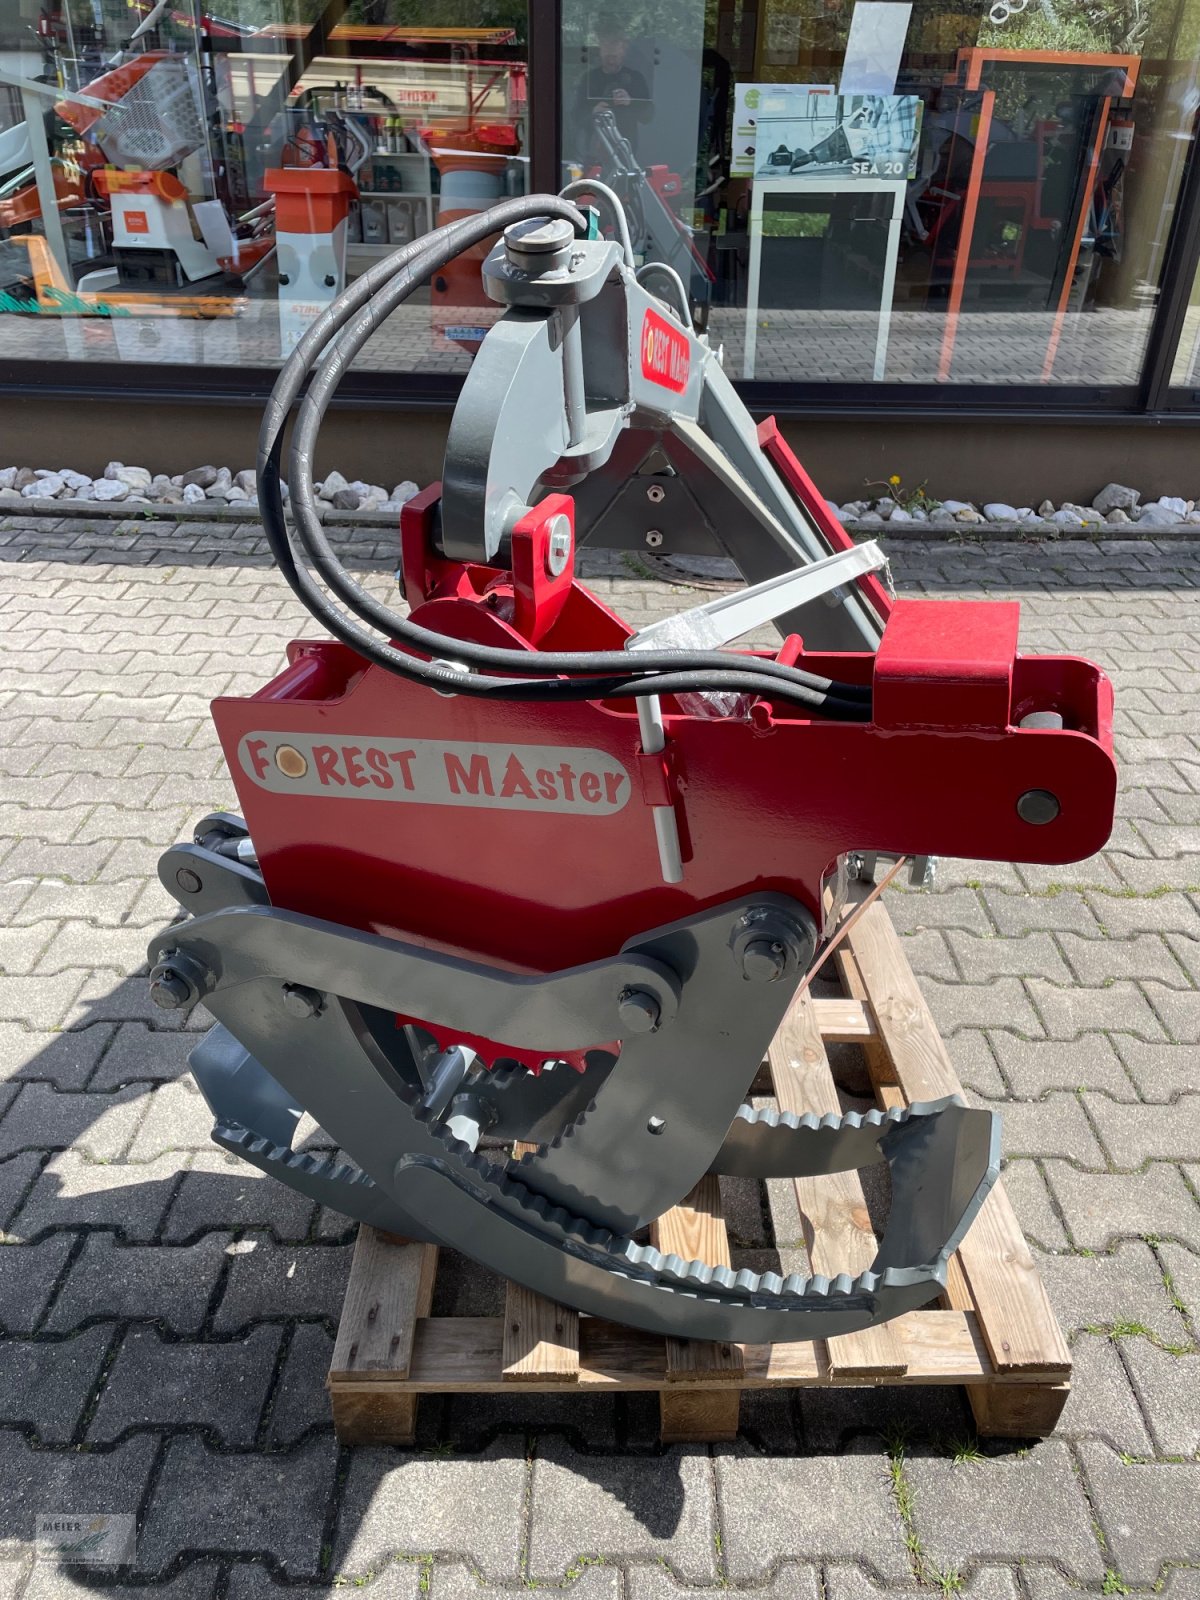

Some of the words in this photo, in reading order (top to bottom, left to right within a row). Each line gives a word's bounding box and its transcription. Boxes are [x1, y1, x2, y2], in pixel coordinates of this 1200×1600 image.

[851, 162, 879, 175] SEA
[883, 162, 904, 175] 20
[245, 739, 416, 792] FOREST
[443, 752, 625, 804] MAster
